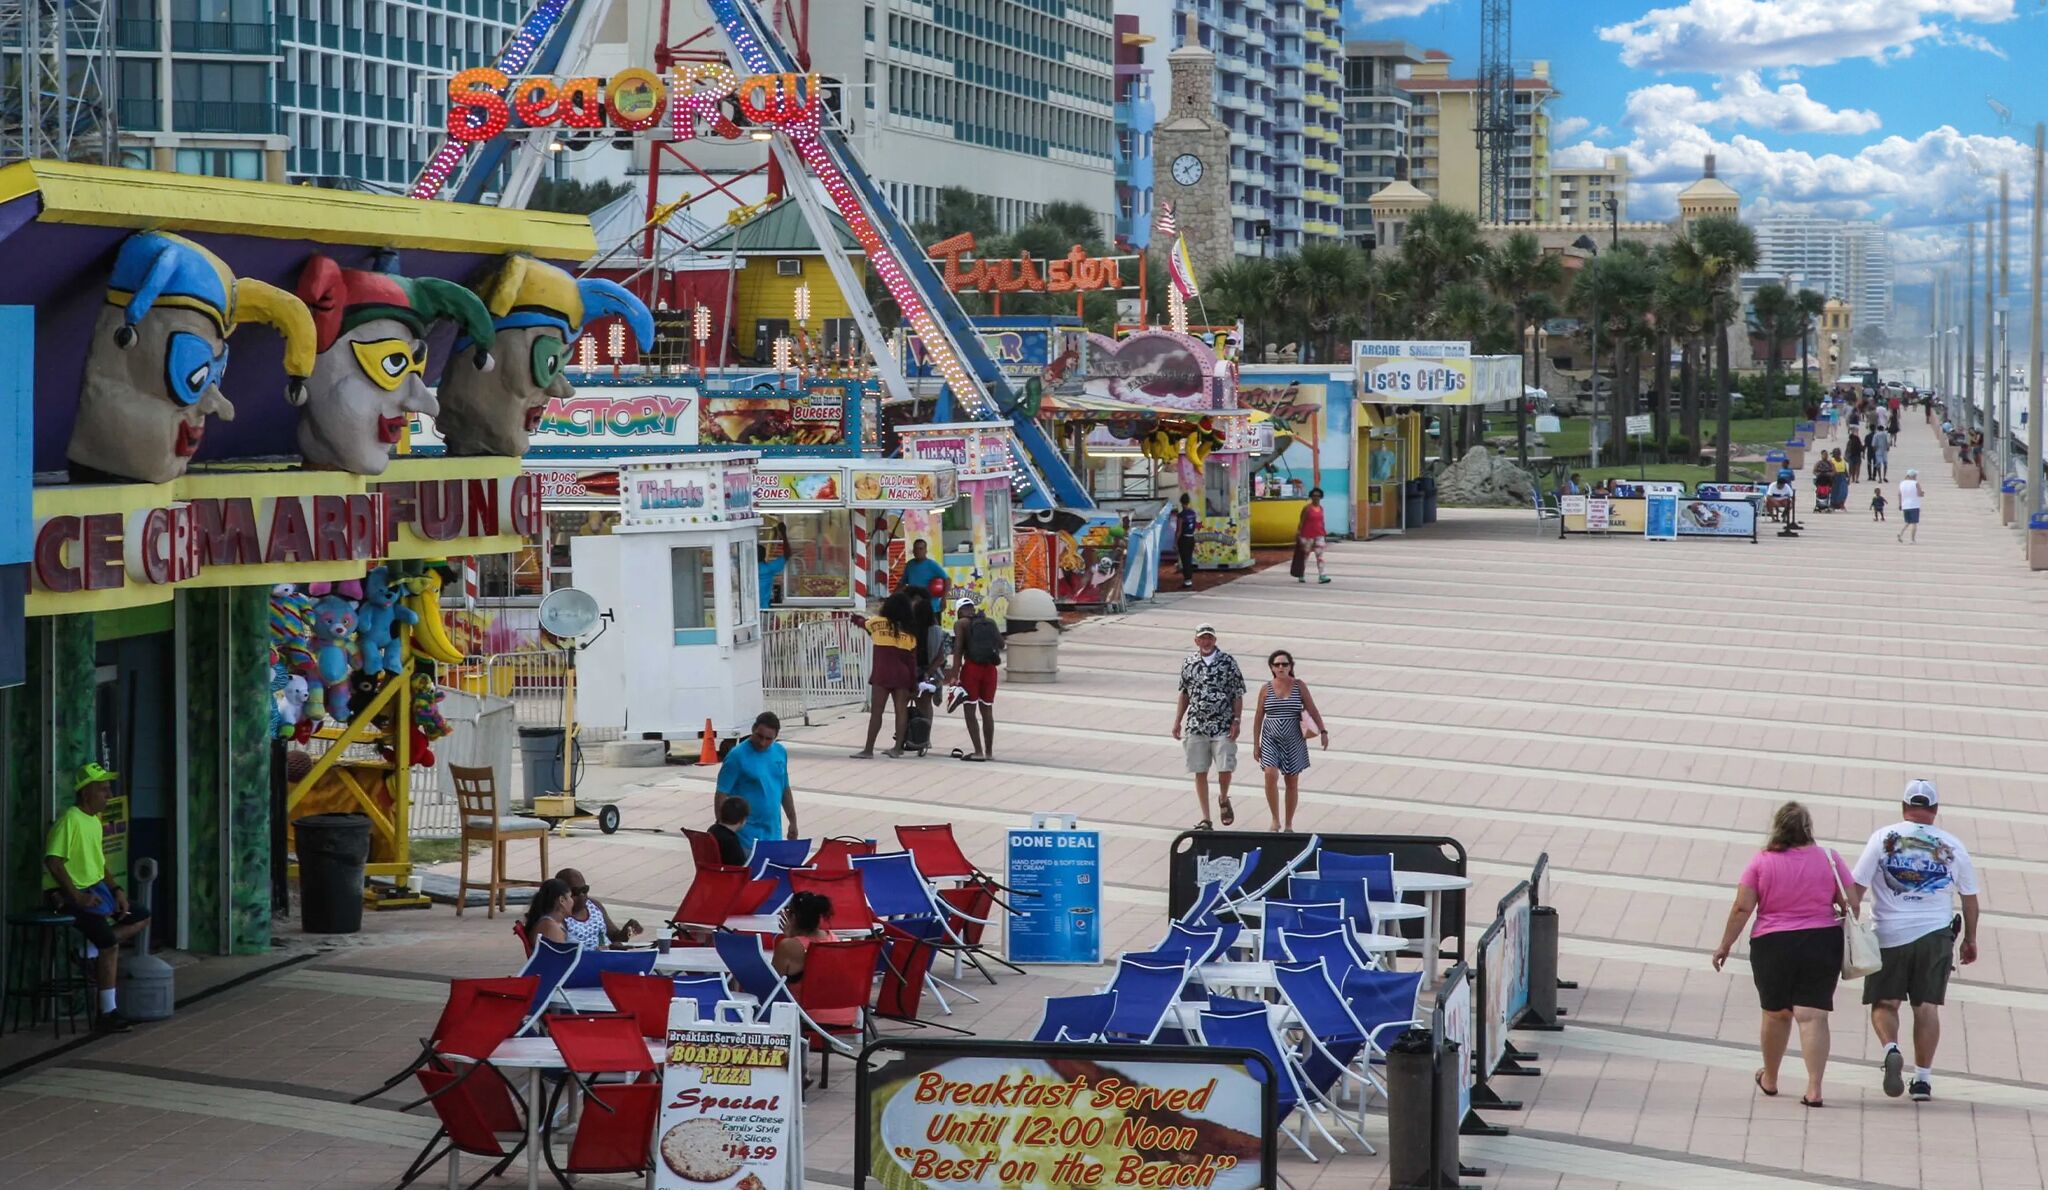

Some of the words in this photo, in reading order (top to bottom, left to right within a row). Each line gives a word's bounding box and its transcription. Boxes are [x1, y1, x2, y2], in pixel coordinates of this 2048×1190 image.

[447, 66, 604, 141] Sea
[673, 63, 820, 148] Ray
[928, 231, 1122, 293] Twister
[1361, 345, 1401, 356] ARCADE
[1364, 370, 1411, 393] Lisa's
[1417, 368, 1466, 391] Gifts
[536, 395, 691, 436] ACTORY
[793, 406, 843, 420] BURGERS
[552, 472, 576, 482] DOGS
[556, 484, 585, 495] DOGS
[637, 479, 705, 509] Tickets
[888, 489, 923, 499] NACHOS
[377, 478, 498, 541] FUN
[192, 493, 388, 566] MARDI
[26, 513, 124, 593] CE
[1011, 836, 1053, 848] DONE
[1057, 836, 1096, 848] DEAL
[670, 1031, 714, 1043] Breakfast
[715, 1033, 746, 1045] Served
[748, 1034, 761, 1045] till
[671, 1045, 785, 1067] BOARDWALK
[700, 1066, 752, 1086] PIZZA
[667, 1088, 780, 1114] Special
[914, 1072, 1088, 1109] Breakfast
[1091, 1073, 1219, 1112] Served
[720, 1114, 747, 1124] Large
[749, 1115, 784, 1124] Cheese
[722, 1123, 752, 1133] Family
[755, 1124, 780, 1134] Style
[730, 1134, 742, 1142] 12
[744, 1134, 772, 1143] Slices
[926, 1111, 1009, 1145] Until
[1013, 1115, 1104, 1147] 12:00
[1114, 1117, 1198, 1150] Noon
[721, 1143, 777, 1160] $14.99
[895, 1146, 998, 1181] “Best
[999, 1158, 1039, 1183] on
[1052, 1154, 1105, 1185] the
[1114, 1154, 1237, 1188] Beach”
